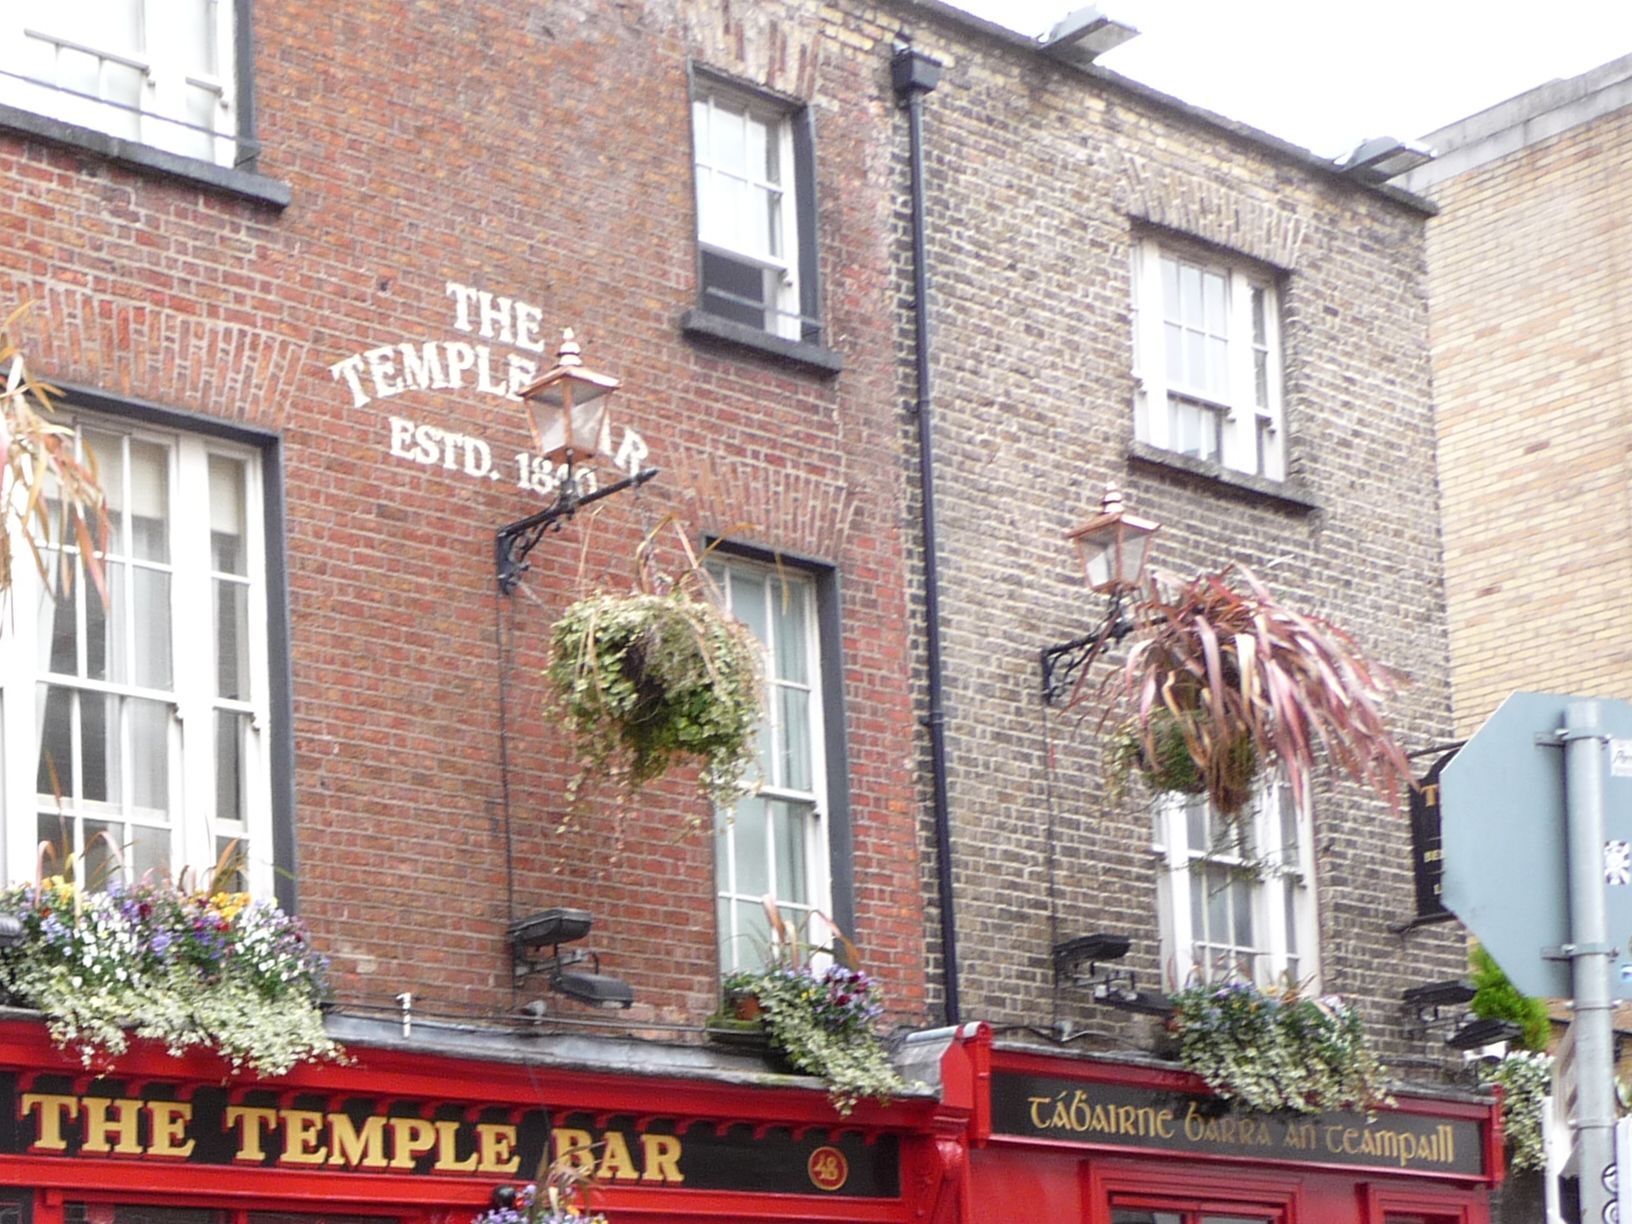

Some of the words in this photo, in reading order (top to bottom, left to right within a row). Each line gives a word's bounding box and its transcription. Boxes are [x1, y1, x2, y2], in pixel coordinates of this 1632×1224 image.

[446, 281, 545, 353] THE
[328, 341, 536, 408] TEMPLE
[389, 415, 502, 481] ESTD.
[20, 1092, 197, 1159] THE
[225, 1104, 521, 1176] TEMPLE
[553, 1127, 686, 1184] BAR
[813, 1153, 839, 1180] 48
